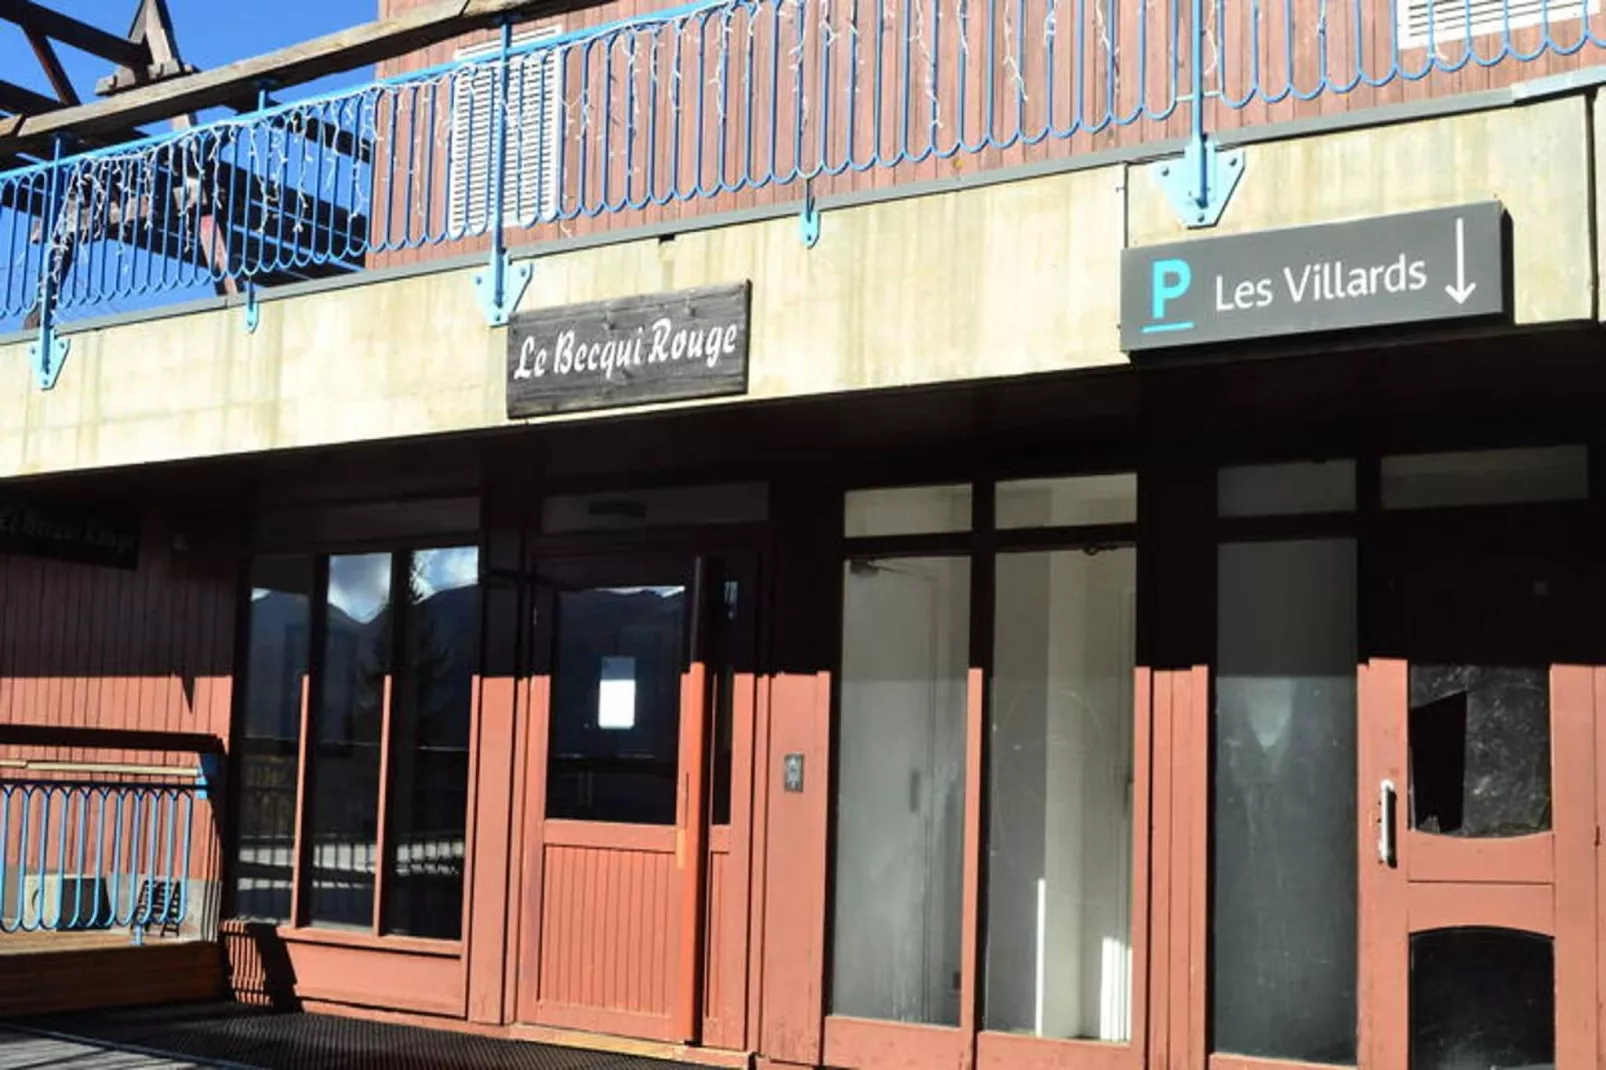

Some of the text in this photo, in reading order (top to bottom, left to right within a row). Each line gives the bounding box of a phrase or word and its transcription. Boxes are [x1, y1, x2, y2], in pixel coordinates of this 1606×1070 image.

[1151, 253, 1428, 319] P Les Villards
[513, 318, 738, 380] Le Becqui Rouge
